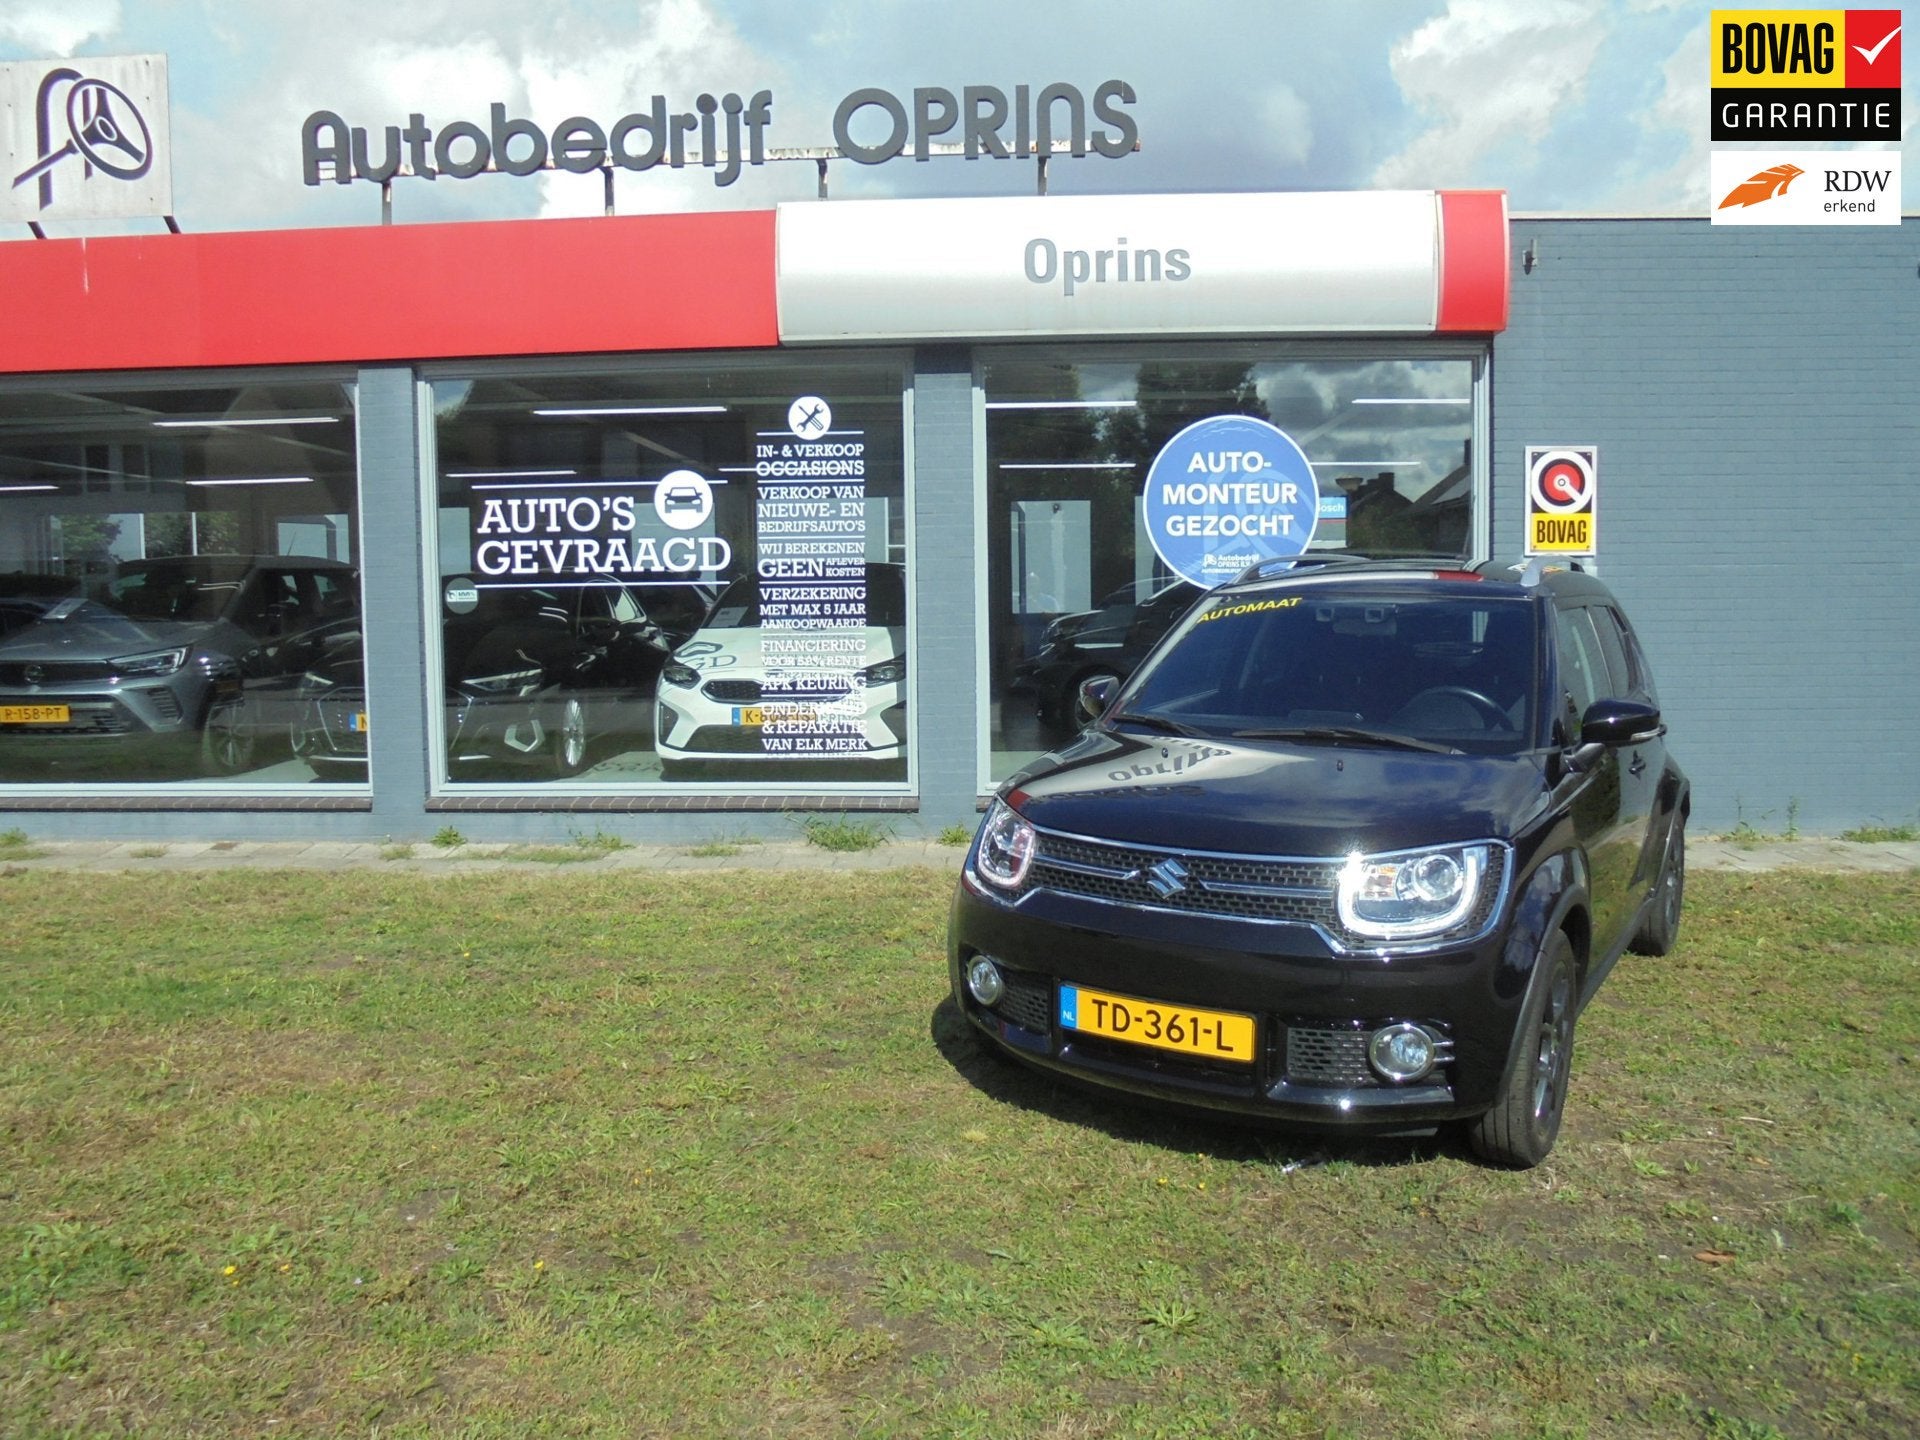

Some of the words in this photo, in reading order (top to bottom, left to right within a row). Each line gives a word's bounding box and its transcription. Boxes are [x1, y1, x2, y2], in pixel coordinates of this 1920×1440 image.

[302, 89, 772, 187] Autobedrijf
[833, 79, 1138, 164] OPRINS
[1024, 237, 1192, 296] Oprins
[756, 444, 778, 457] IN-
[781, 444, 793, 457] &
[794, 443, 865, 457] VERKOOP
[756, 460, 865, 476] OCCASIONS
[1187, 451, 1272, 474] AUTO-
[757, 486, 831, 499] VERKOOP
[832, 485, 865, 498] VAN
[1162, 483, 1298, 506] MONTEUR
[477, 496, 636, 534] AUTO'S
[758, 502, 836, 518] NIEUWE-
[840, 502, 865, 517] EN
[758, 520, 866, 533] BEDRIJFSAUTO'S
[1165, 514, 1295, 537] GEZOCHT
[1536, 520, 1587, 543] BOVAG
[477, 537, 732, 575] GEVRAAGD
[758, 543, 783, 555] WIJ
[785, 542, 865, 555] BEREKENEN
[757, 558, 825, 578] GEEN
[826, 557, 866, 566] AFLEVER
[826, 568, 866, 577] KOSTEN
[759, 587, 866, 601] VERZEKERING
[759, 604, 788, 616] MET
[791, 604, 821, 615] MAX
[824, 604, 832, 615] 5
[833, 603, 866, 615] JAAR
[1196, 597, 1302, 623] AUTOMAAT
[760, 618, 867, 629] AANKOOPWAARDE
[760, 639, 866, 652] FINANCIERING
[761, 655, 795, 666] VOOR
[827, 655, 867, 666] RENTE
[761, 678, 793, 690] APK
[796, 677, 866, 690] KEURING
[761, 721, 775, 734] &
[776, 721, 867, 734] REPARATIE
[761, 739, 793, 751] VAN
[795, 739, 824, 750] ELK
[826, 738, 868, 750] MERK
[1062, 1010, 1075, 1022] NL
[1091, 998, 1234, 1053] TD-361-L
